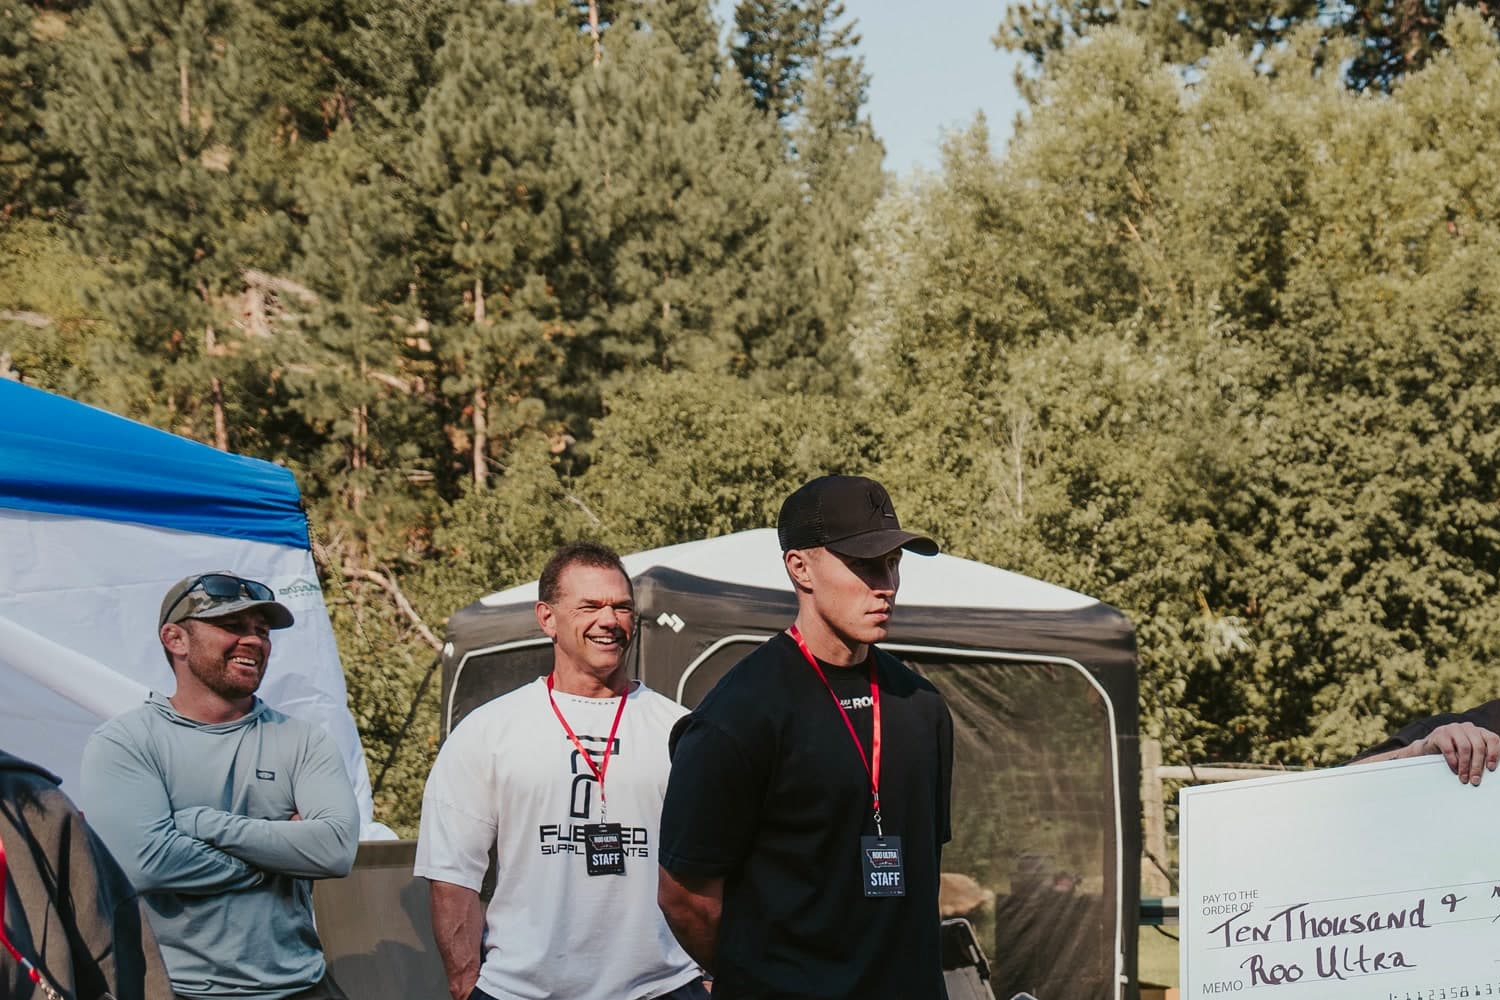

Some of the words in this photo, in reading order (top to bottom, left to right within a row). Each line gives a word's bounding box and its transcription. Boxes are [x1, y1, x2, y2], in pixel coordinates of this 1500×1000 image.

[539, 824, 648, 845] FUEED
[541, 844, 649, 857] SUPPLNTS
[592, 853, 620, 866] STAFF
[870, 872, 900, 886] STAFF
[1202, 893, 1224, 905] PAY
[1224, 891, 1237, 902] TO
[1239, 889, 1258, 900] THE
[1202, 903, 1239, 916] ORDER
[1240, 901, 1255, 913] OF
[1240, 954, 1304, 986] Roo
[1202, 979, 1244, 994] MEMO
